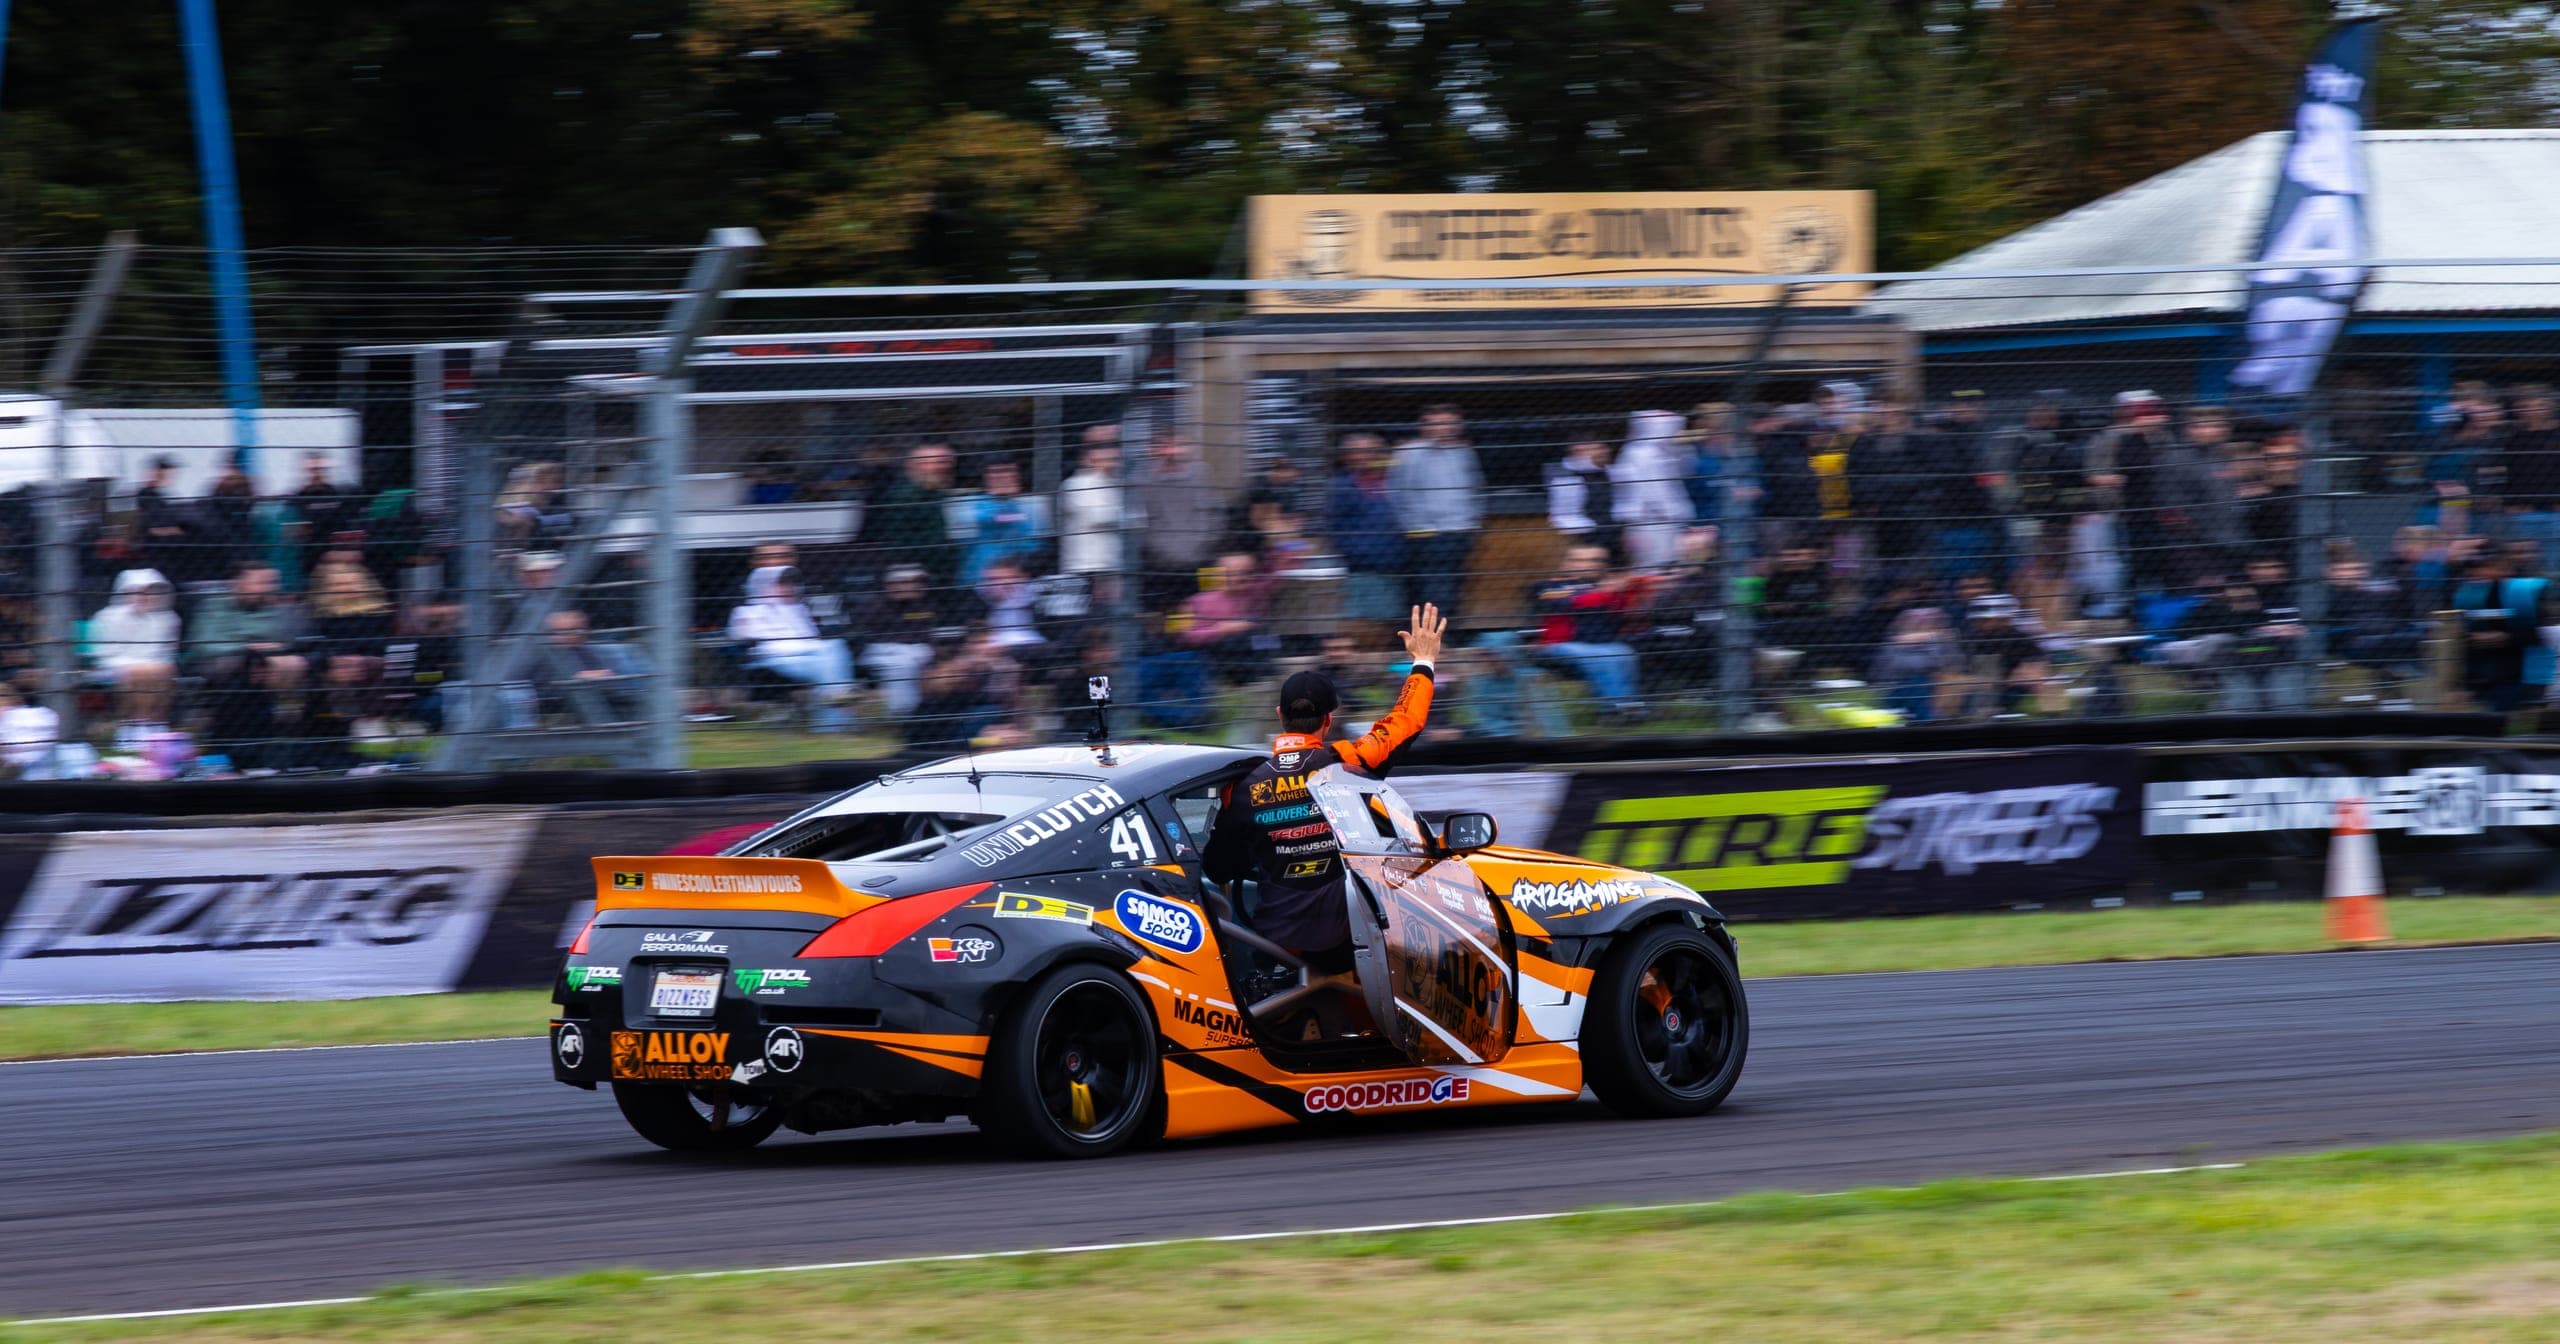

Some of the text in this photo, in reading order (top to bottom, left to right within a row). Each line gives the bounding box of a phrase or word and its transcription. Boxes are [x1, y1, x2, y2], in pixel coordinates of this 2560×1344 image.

[961, 784, 1125, 867] UNICLUTCH
[1110, 814, 1157, 860] 41
[1275, 839, 1336, 854] MAGNUSON
[1127, 897, 1191, 929] SAMCO
[643, 933, 677, 943] GALA
[1145, 921, 1186, 940] sport
[639, 943, 729, 954] PERFORMANCE
[759, 969, 812, 986] TOOL
[645, 1032, 731, 1063] ALLOY
[645, 1064, 733, 1080] WHEEL SHOP
[1305, 1076, 1470, 1113] GOODRIDGE
